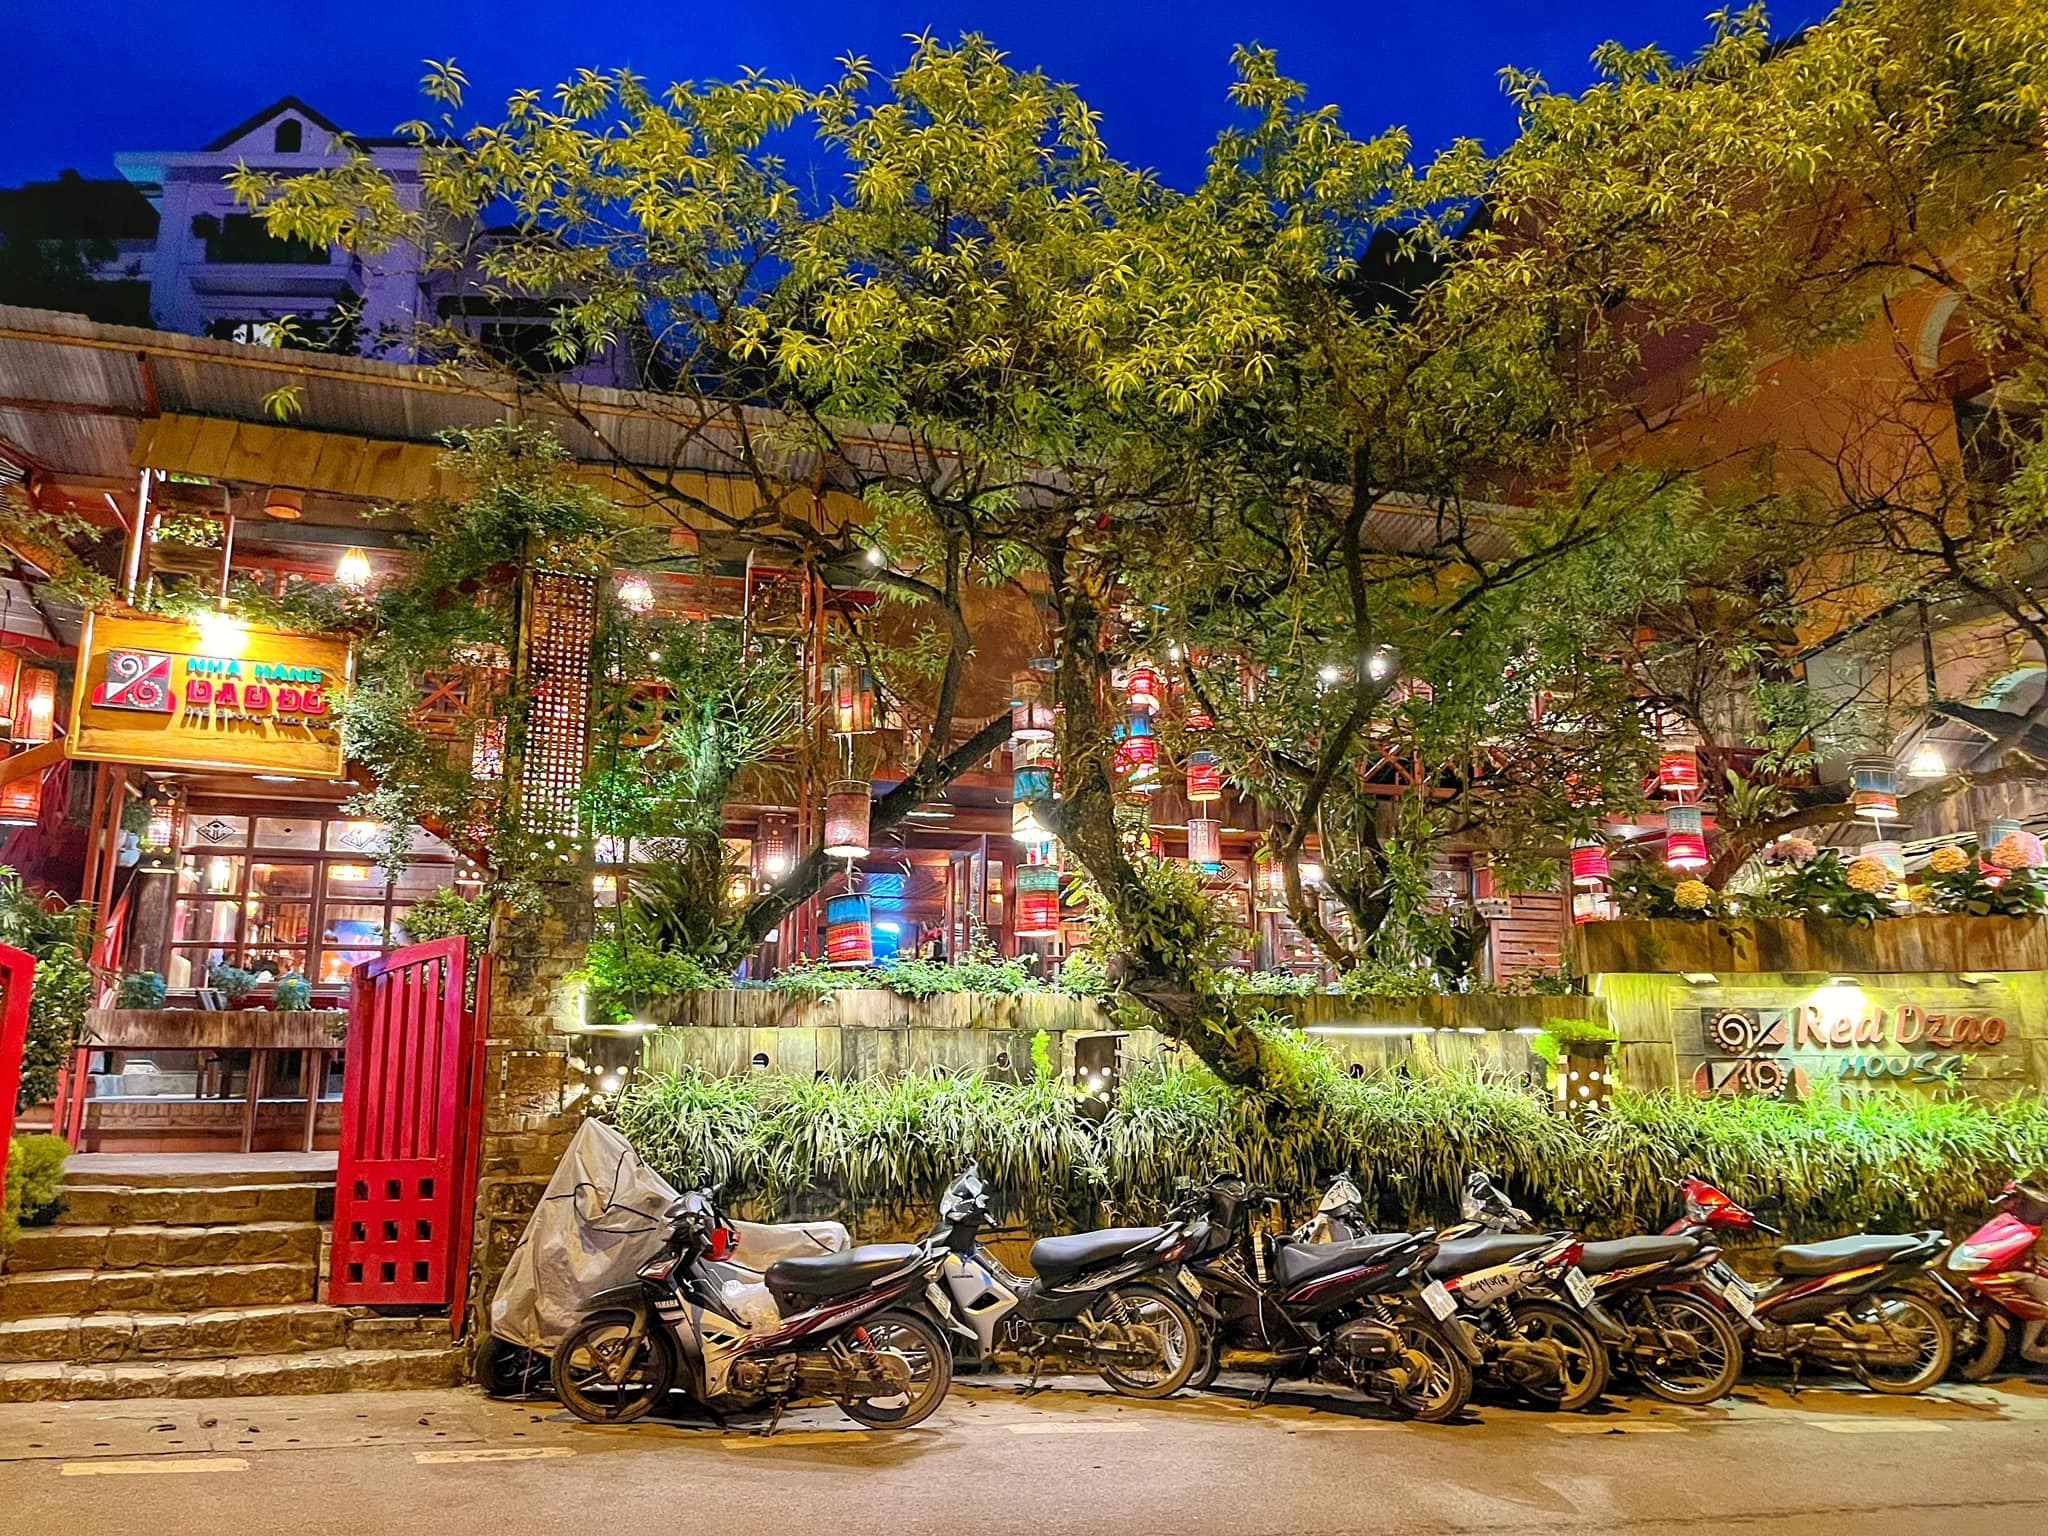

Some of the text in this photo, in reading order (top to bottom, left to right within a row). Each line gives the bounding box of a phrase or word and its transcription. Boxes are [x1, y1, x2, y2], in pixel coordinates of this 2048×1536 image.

[187, 679, 269, 708] DAO
[1798, 1004, 2005, 1047] Red Dzao
